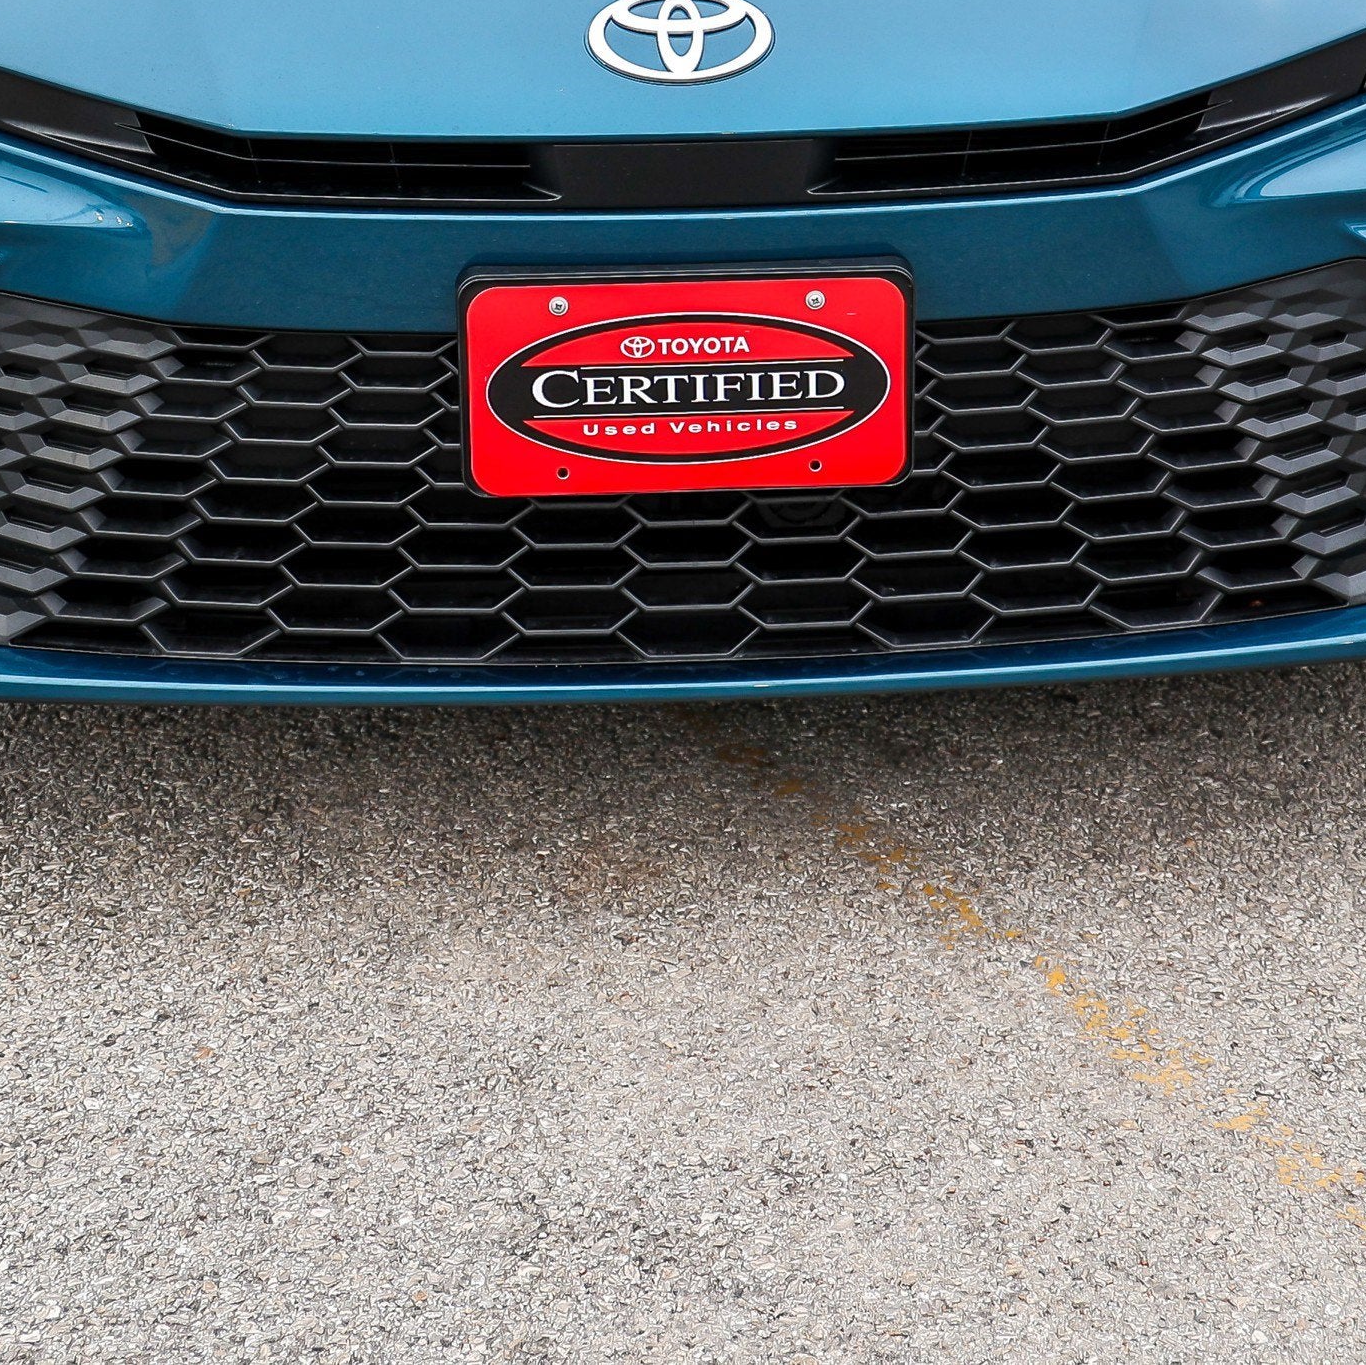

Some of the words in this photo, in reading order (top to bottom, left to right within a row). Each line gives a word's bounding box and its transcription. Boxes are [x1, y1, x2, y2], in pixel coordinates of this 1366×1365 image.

[657, 336, 751, 356] TOYOTA
[531, 368, 846, 409] CERTIFIED
[582, 420, 656, 437] Used
[669, 418, 798, 434] Vehicles
